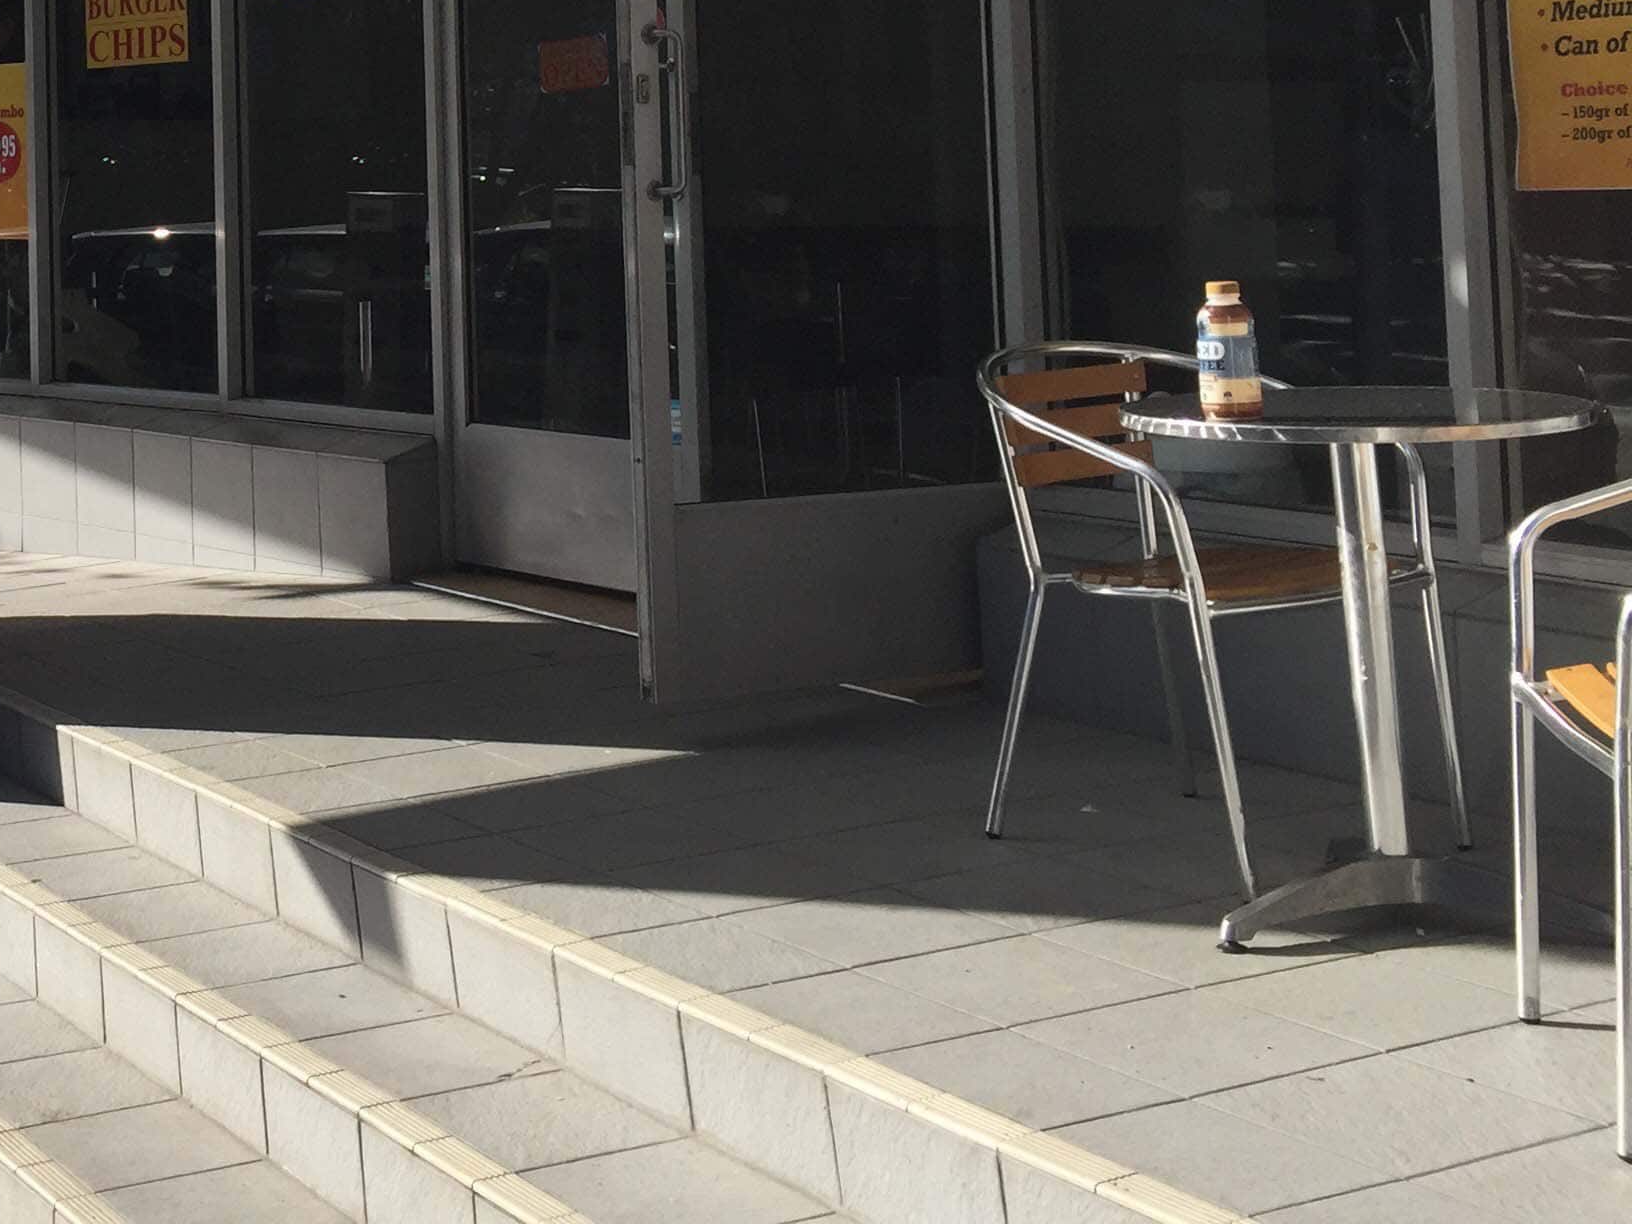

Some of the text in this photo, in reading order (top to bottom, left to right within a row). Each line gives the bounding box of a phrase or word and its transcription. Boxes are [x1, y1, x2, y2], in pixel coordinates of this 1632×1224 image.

[89, 23, 186, 63] CHIPS
[1554, 31, 1632, 57] Can of
[1560, 81, 1629, 98] Choice
[1572, 103, 1630, 122] 150gr of
[1572, 126, 1631, 144] 200gr of
